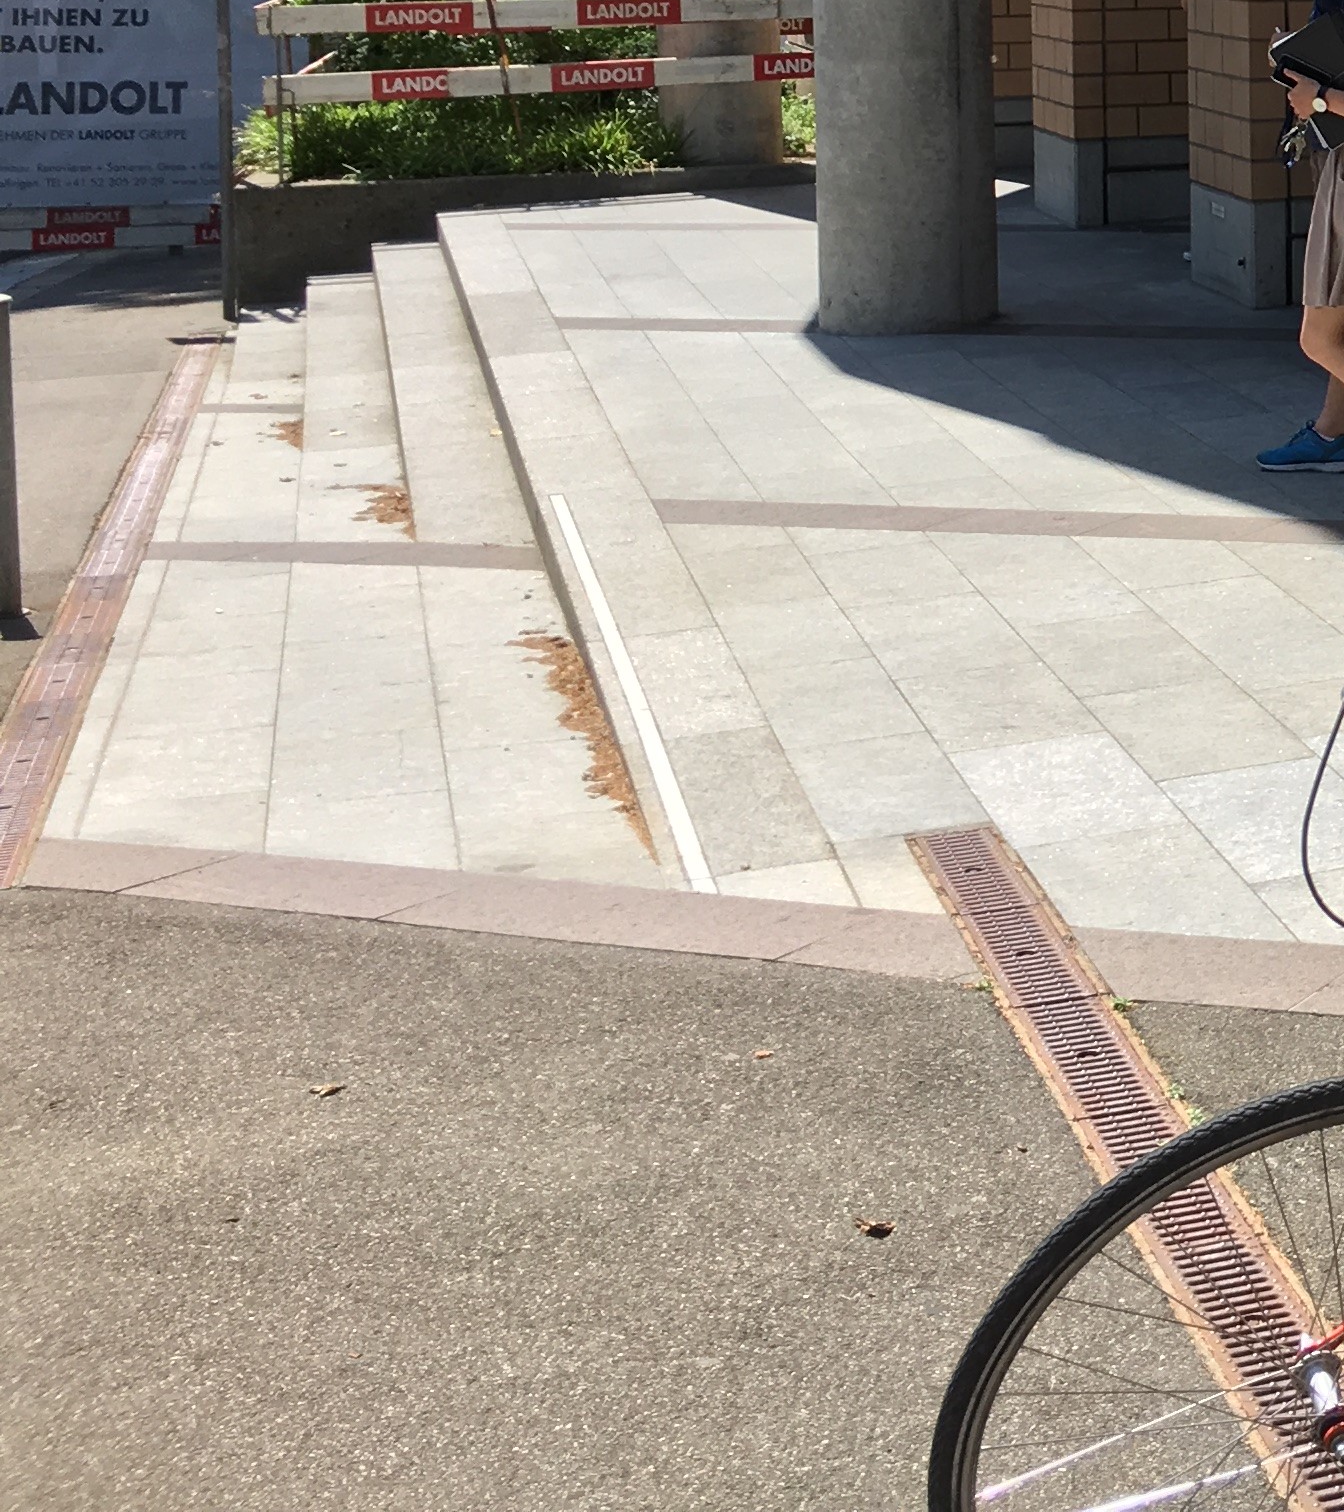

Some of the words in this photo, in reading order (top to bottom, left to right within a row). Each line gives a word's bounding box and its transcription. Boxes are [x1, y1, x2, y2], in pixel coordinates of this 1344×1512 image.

[12, 7, 101, 27] IHNEN
[112, 8, 149, 27] ZU
[375, 7, 462, 26] LANDOLT
[586, 1, 670, 20] LANDOLT
[0, 34, 104, 54] BAUEN.
[561, 66, 645, 86] LANDOLT
[763, 58, 815, 76] LAND
[0, 79, 188, 115] ANDOLT
[78, 129, 136, 141] LANDOLT
[138, 128, 187, 141] GRUPPE
[54, 210, 122, 225] LANDOLT
[40, 231, 107, 246] LANDOLT
